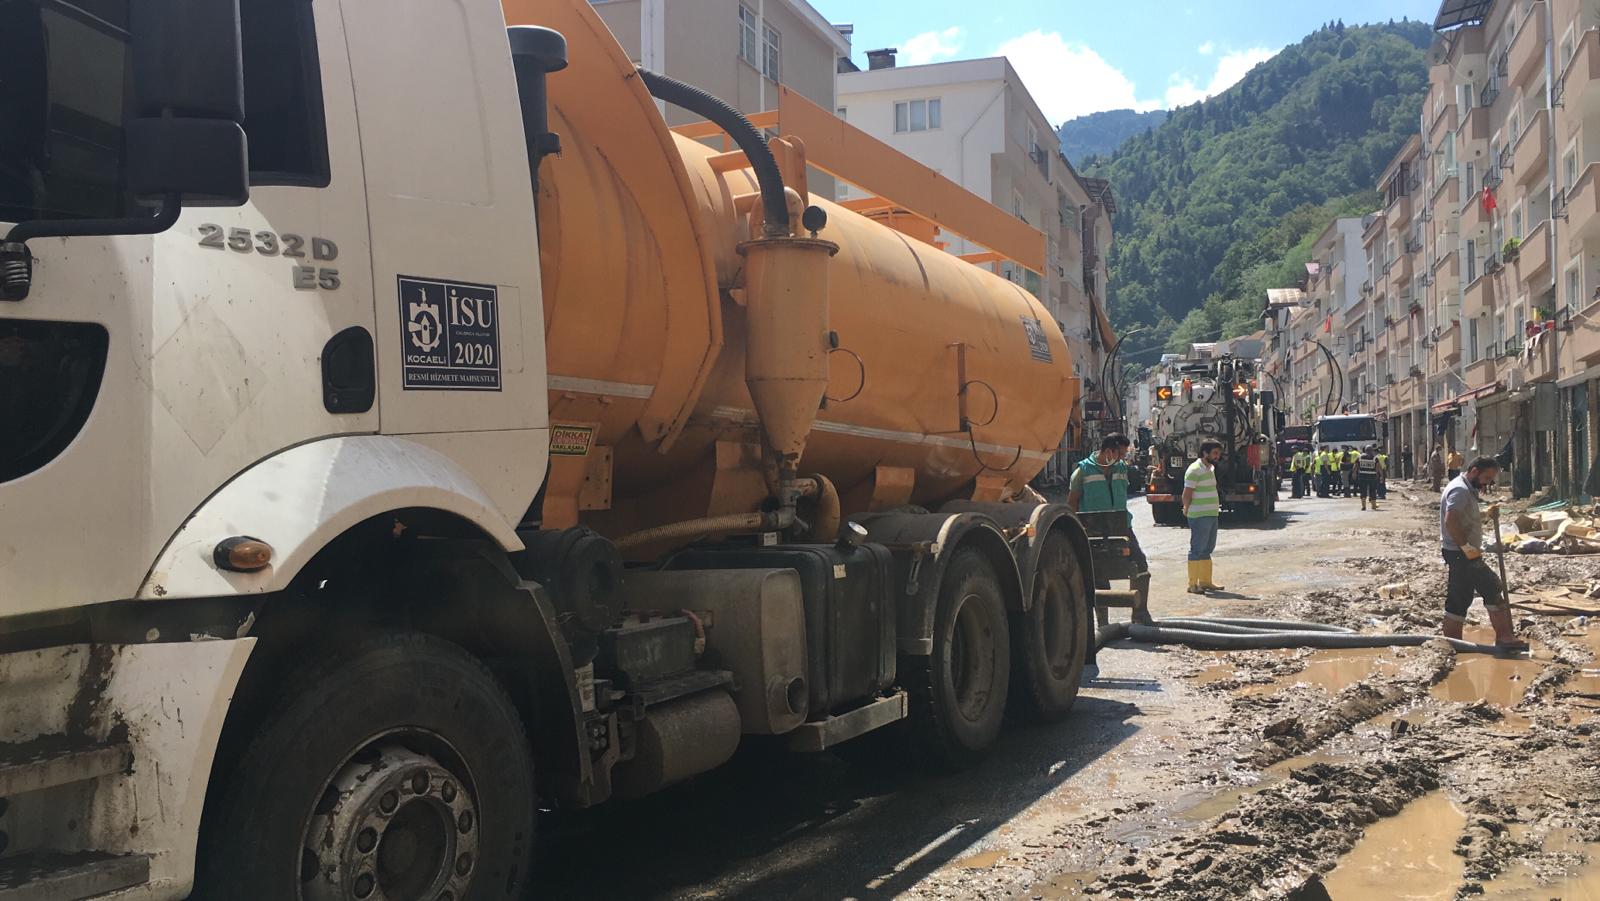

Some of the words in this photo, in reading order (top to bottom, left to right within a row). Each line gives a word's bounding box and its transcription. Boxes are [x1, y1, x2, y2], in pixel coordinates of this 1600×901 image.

[292, 265, 340, 290] E5
[450, 288, 493, 328] İSU
[454, 342, 493, 365] 2020
[408, 373, 429, 381] RESMİ
[430, 373, 459, 382] HİZMETE
[555, 430, 589, 439] DİKKAT
